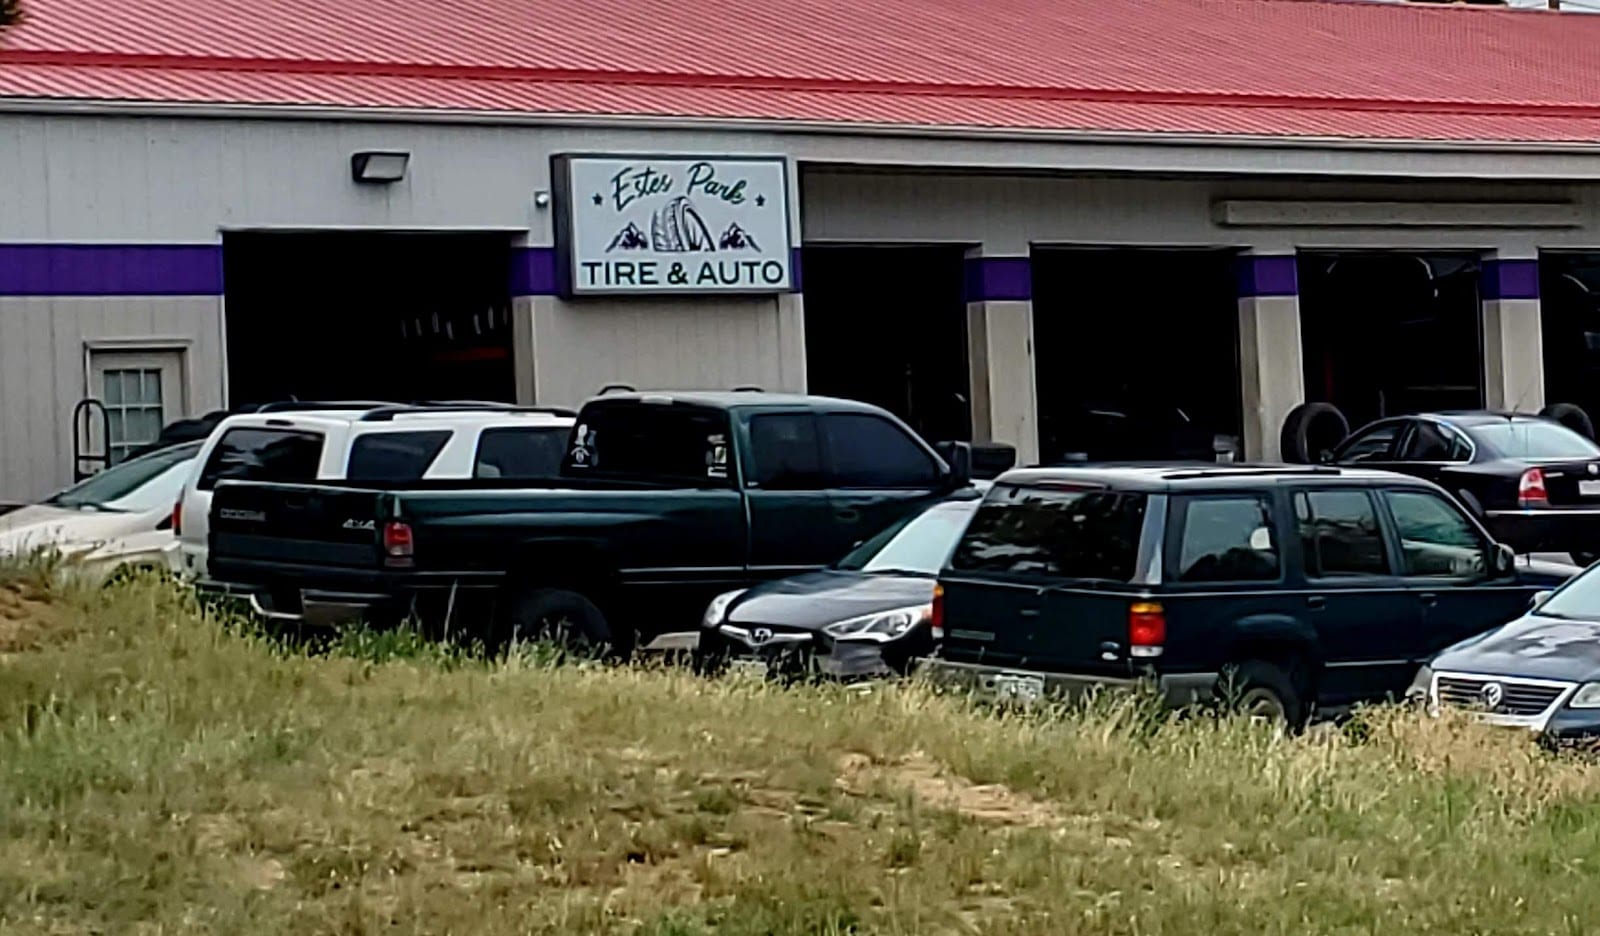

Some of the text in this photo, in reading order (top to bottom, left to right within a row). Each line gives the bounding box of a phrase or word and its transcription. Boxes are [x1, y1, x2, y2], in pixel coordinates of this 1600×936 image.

[611, 162, 747, 212] Estes Park
[581, 260, 784, 286] TIRE & AUTO
